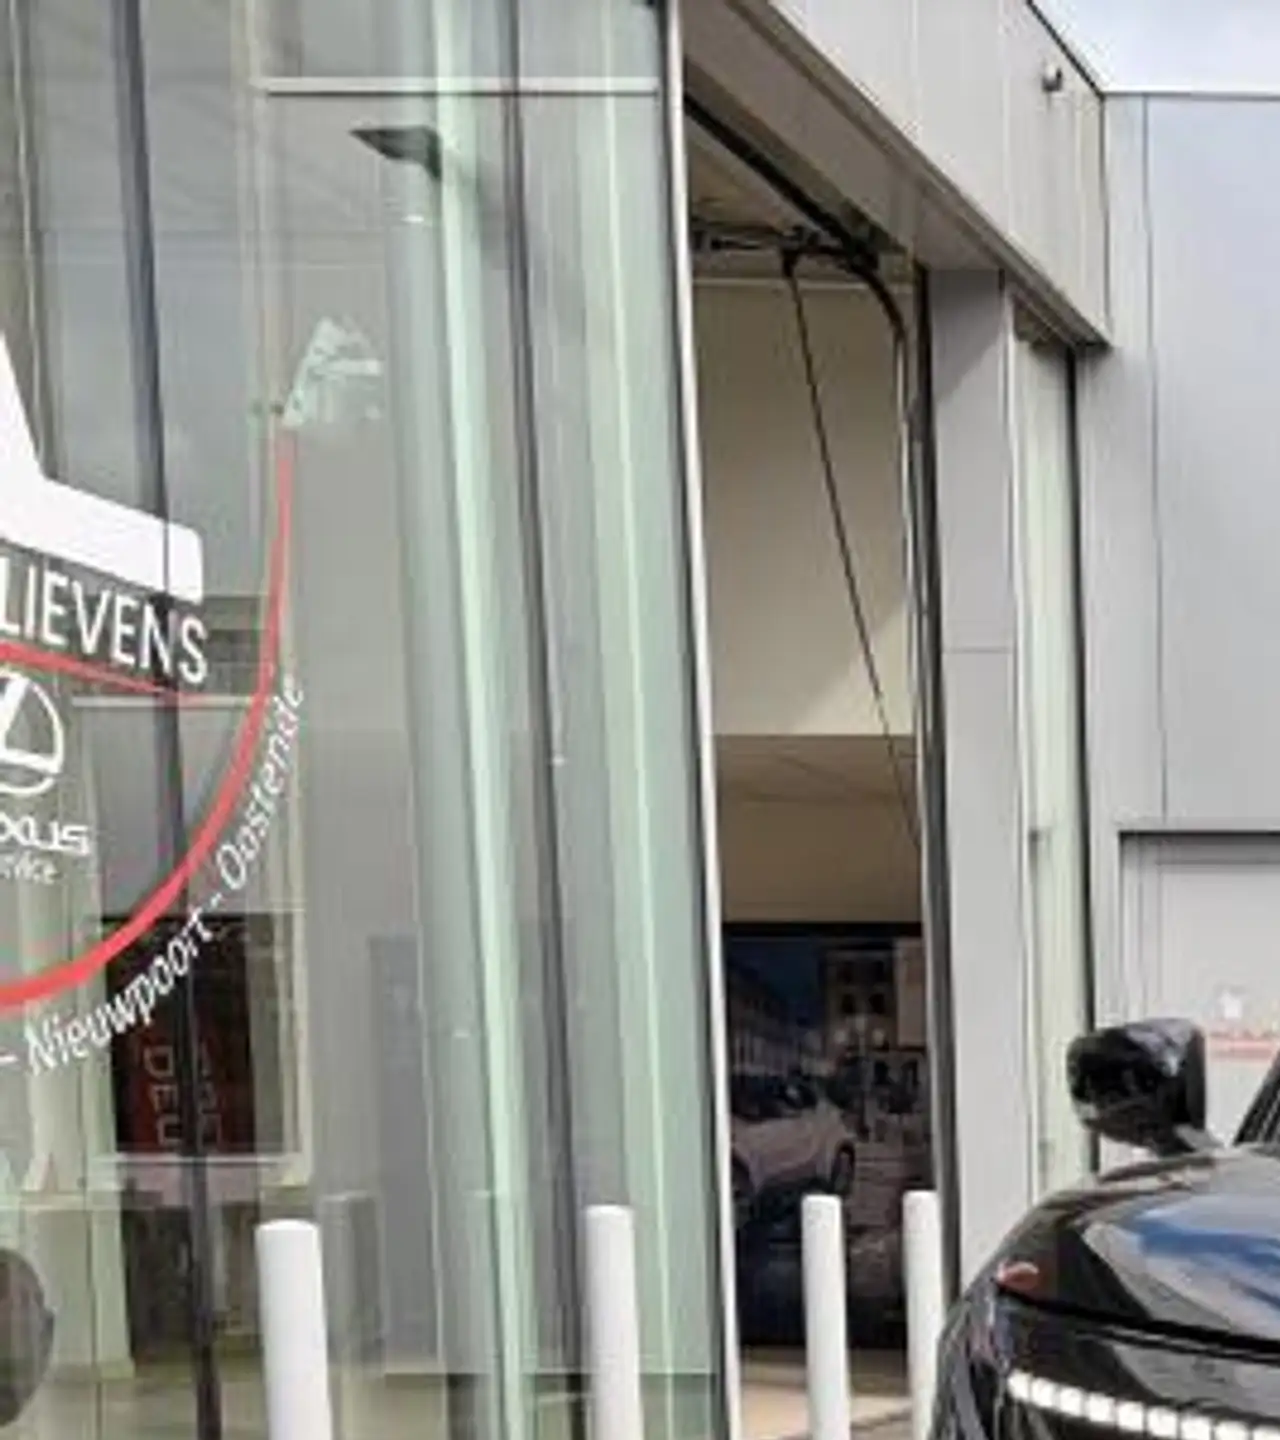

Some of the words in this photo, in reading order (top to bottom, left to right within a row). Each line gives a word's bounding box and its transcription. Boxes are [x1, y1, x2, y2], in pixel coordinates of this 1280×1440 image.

[0, 557, 208, 684] LIEVENS
[24, 904, 213, 1076] Nieuwpoort
[216, 671, 304, 890] Oostende
